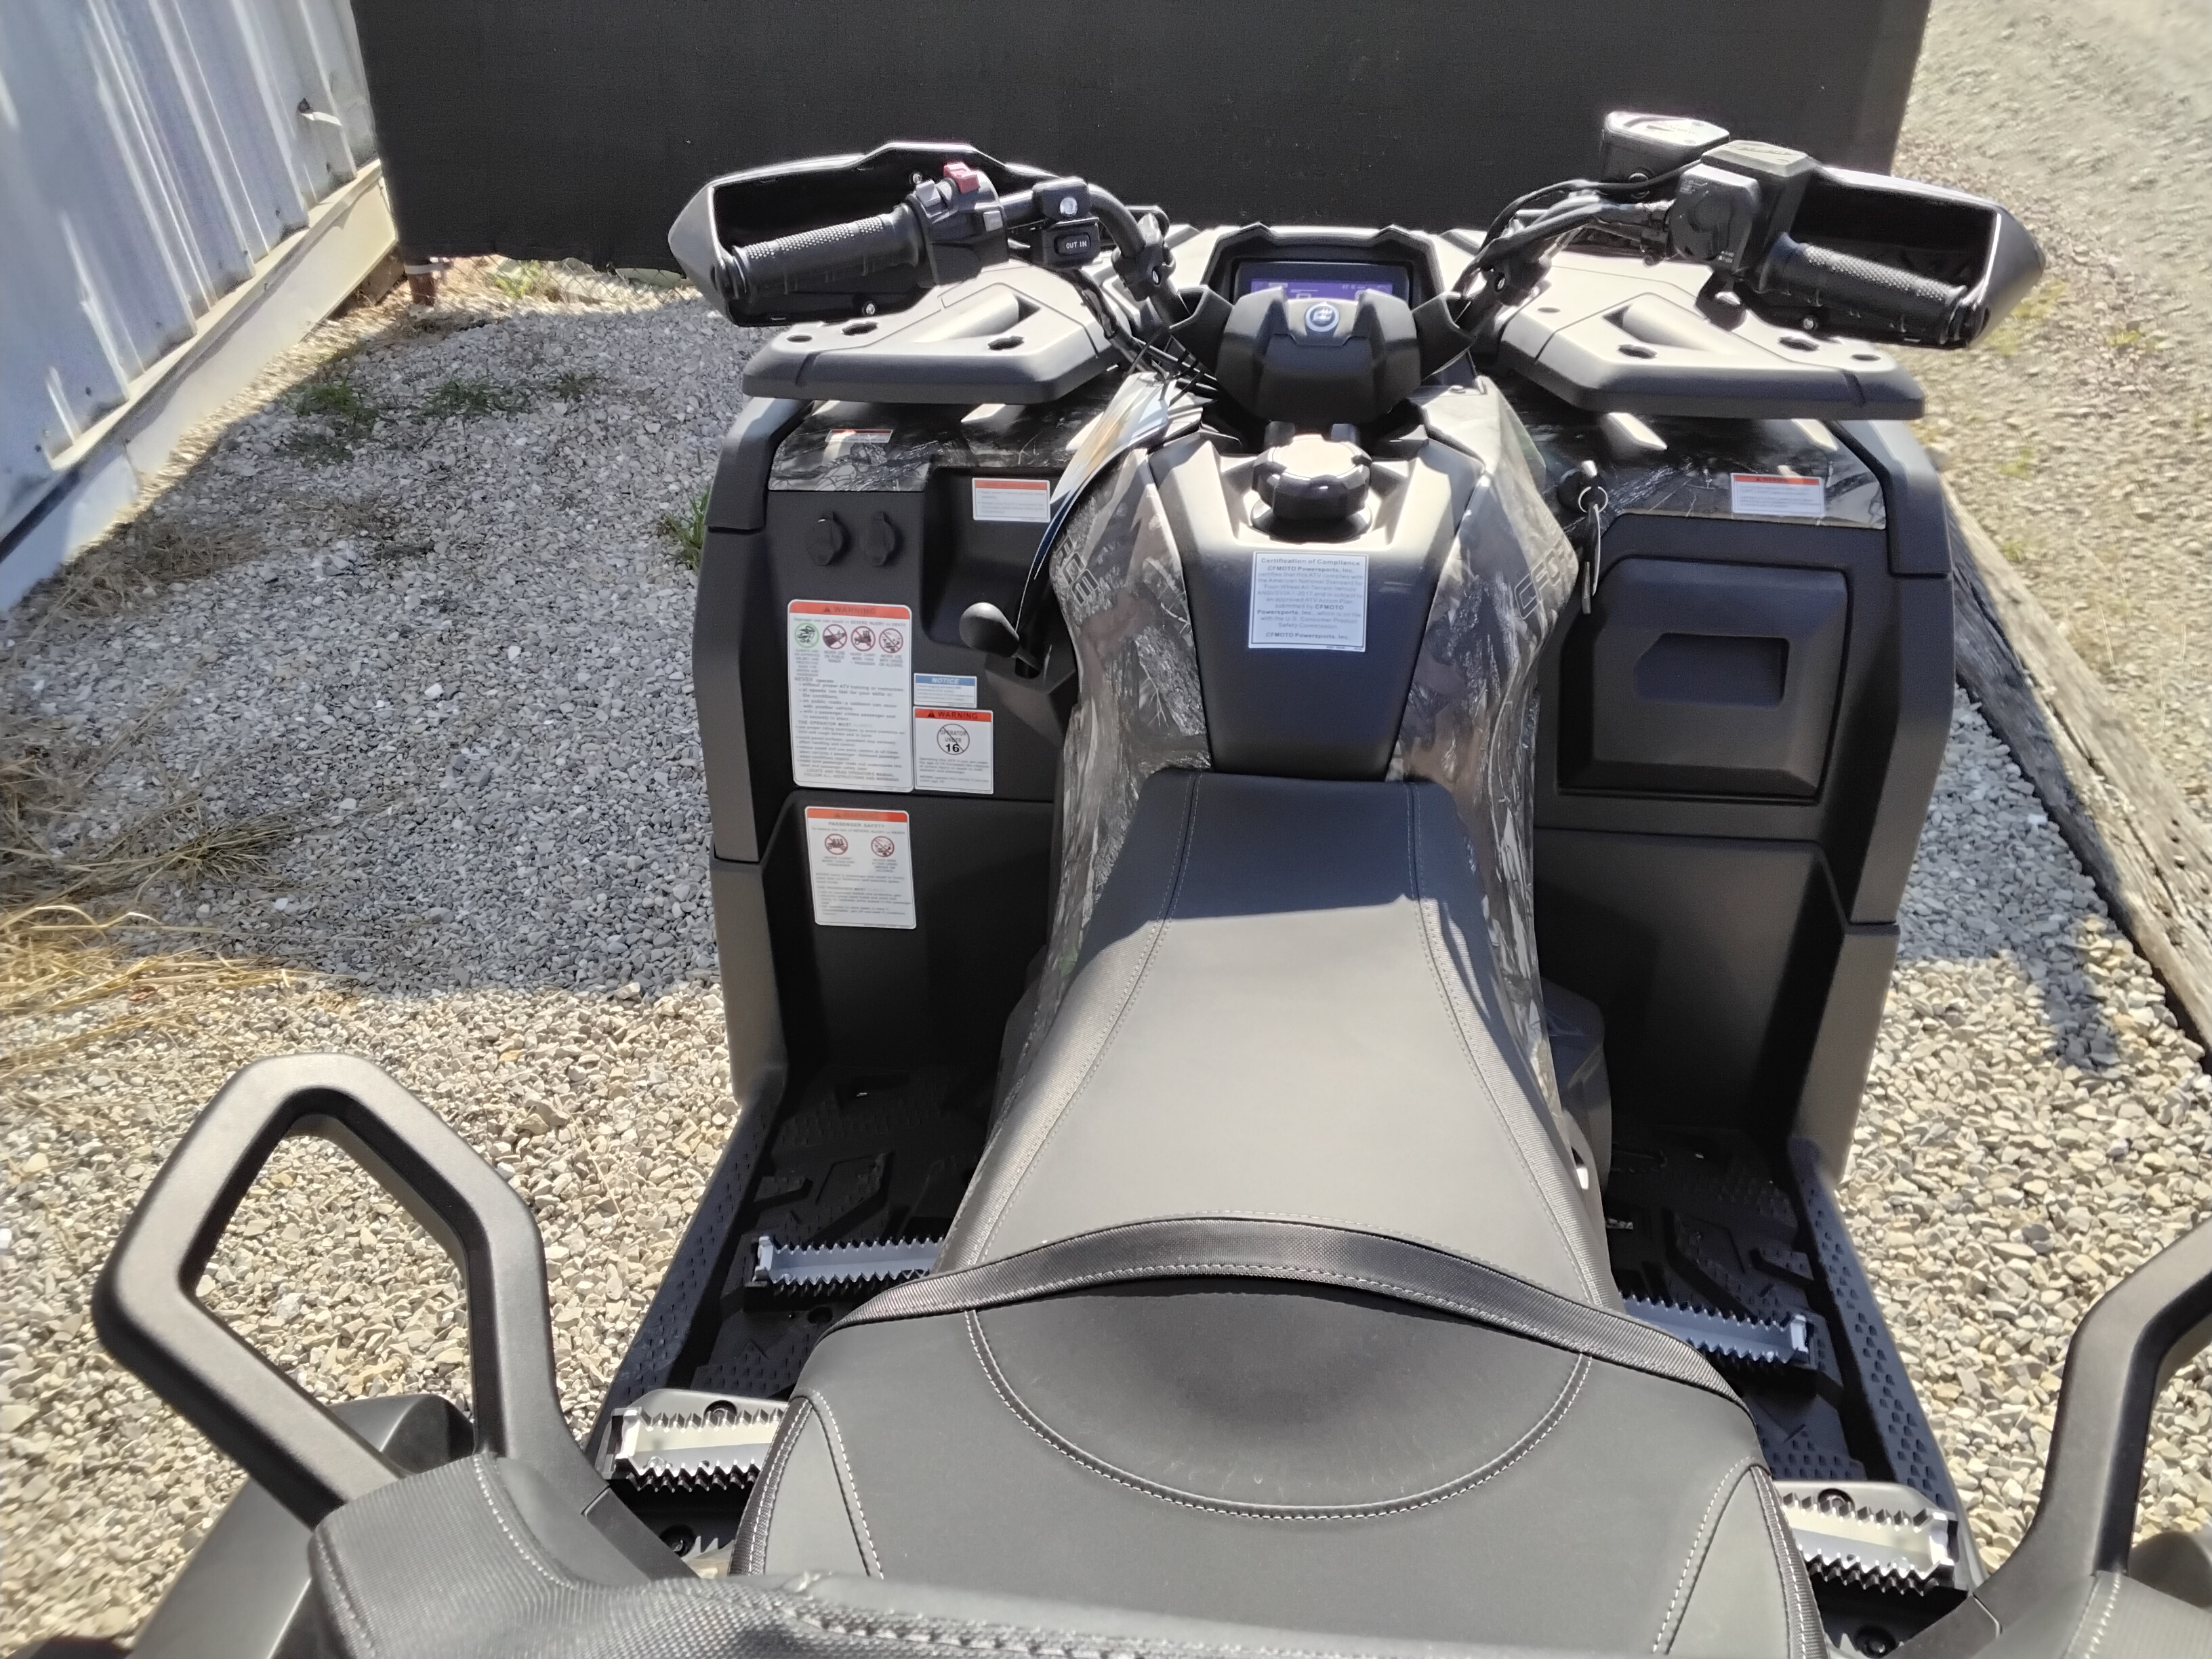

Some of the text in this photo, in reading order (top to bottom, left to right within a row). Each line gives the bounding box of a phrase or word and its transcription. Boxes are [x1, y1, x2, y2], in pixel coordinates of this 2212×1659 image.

[1065, 241, 1078, 249] OUT
[834, 605, 876, 615] WARNING
[938, 712, 978, 720] WARNING
[945, 743, 960, 753] 16
